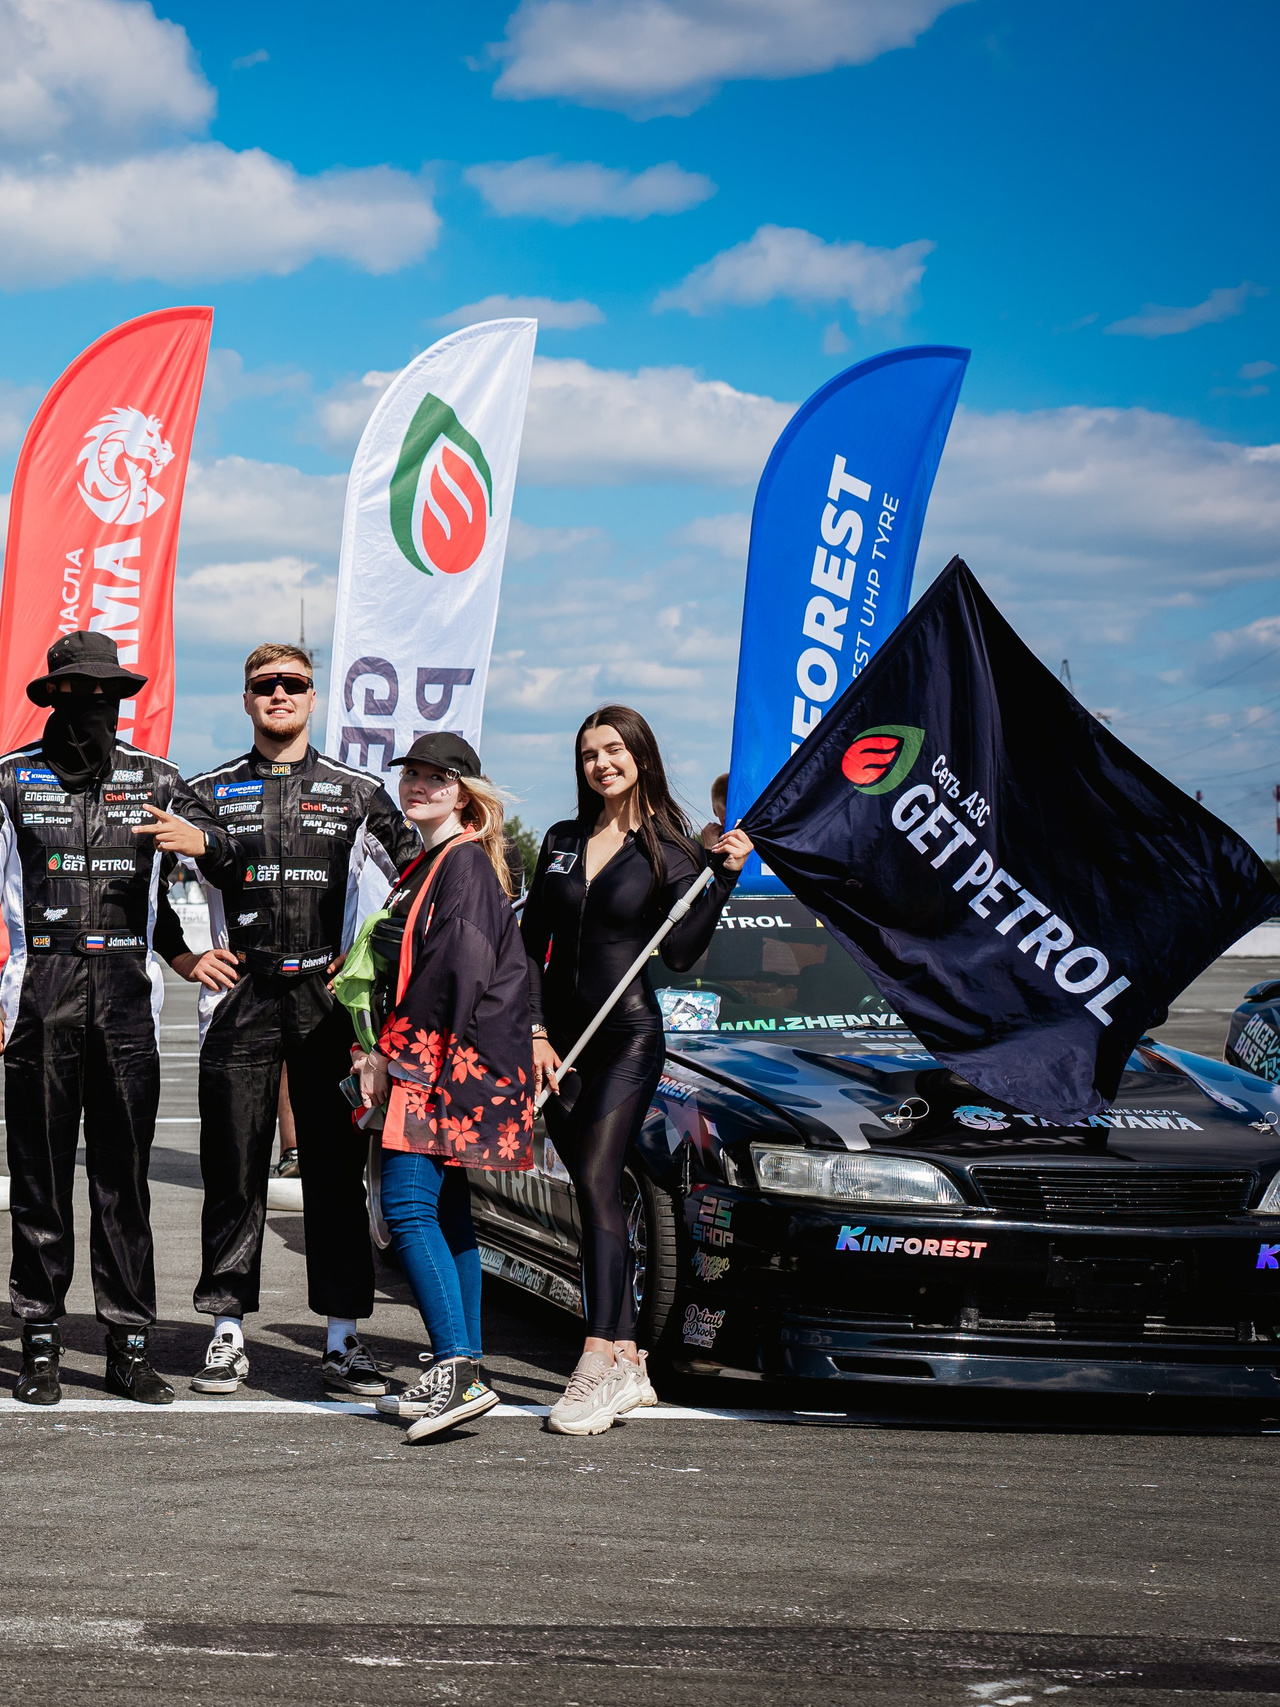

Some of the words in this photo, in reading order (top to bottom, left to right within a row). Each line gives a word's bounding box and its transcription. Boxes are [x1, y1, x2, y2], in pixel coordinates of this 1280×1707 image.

[860, 565, 880, 629] UHP
[872, 492, 900, 560] TYRE
[789, 454, 872, 760] FOREST
[105, 792, 148, 802] ChelParts
[932, 753, 961, 800] Сеть
[959, 790, 992, 828] АЗС
[22, 813, 44, 824] 25
[45, 816, 72, 824] SHOP
[122, 817, 141, 825] PRO
[301, 802, 344, 814] ChelParts
[236, 825, 263, 834] SHOP
[316, 827, 335, 835] PRO
[62, 860, 86, 871] GET
[91, 859, 136, 871] PETROL
[256, 870, 280, 881] GET
[284, 869, 328, 881] PETROL
[891, 784, 977, 869] GET
[952, 848, 1132, 1027] PETROL
[1243, 1012, 1275, 1050] RACE
[1233, 1031, 1264, 1072] BASE
[656, 1074, 700, 1100] OREST
[699, 1195, 734, 1229] 25
[692, 1222, 734, 1248] SHOP
[835, 1225, 988, 1260] KINFOREST
[509, 1259, 542, 1292] ChelParts
[685, 1303, 726, 1328] Detail
